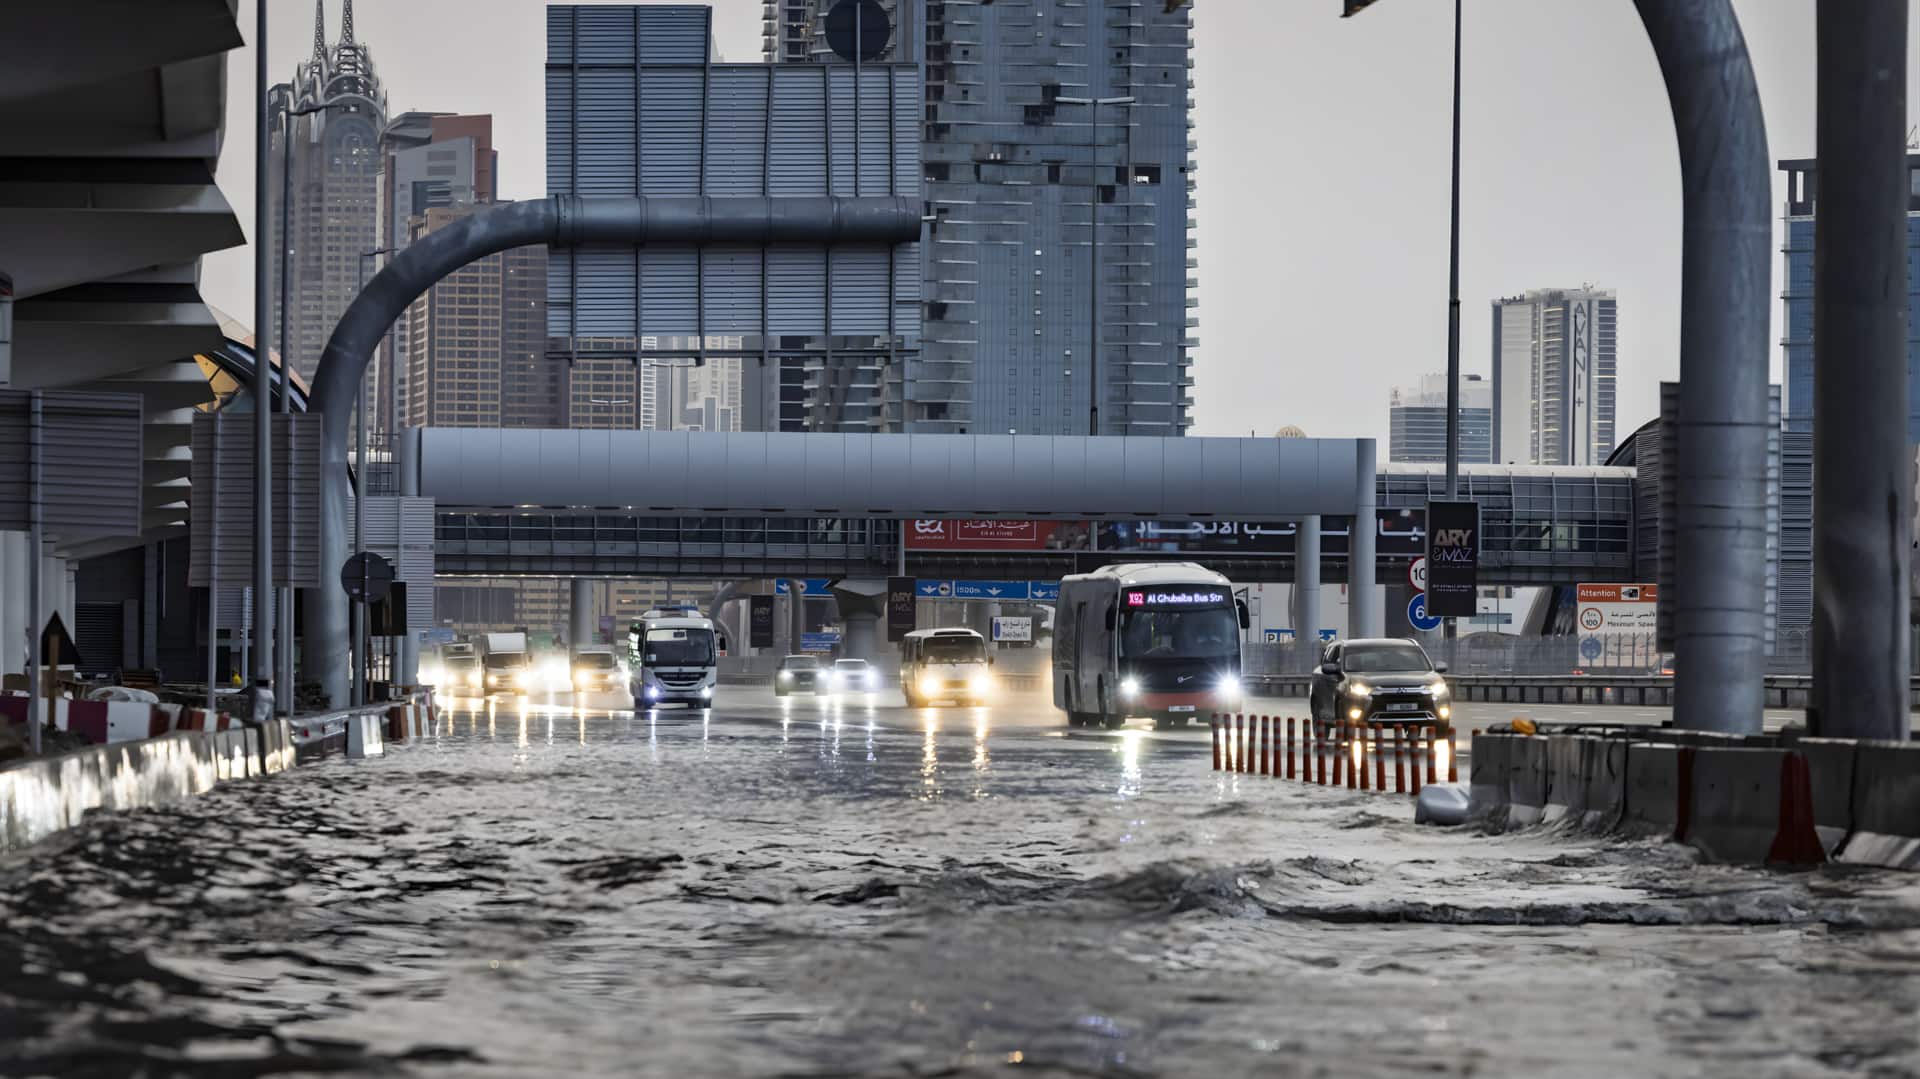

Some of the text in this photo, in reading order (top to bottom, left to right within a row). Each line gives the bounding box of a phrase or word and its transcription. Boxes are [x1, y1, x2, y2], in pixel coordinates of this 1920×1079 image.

[1433, 529, 1472, 546] ARY
[1413, 567, 1425, 580] 10
[1147, 594, 1156, 603] Al
[1194, 593, 1208, 602] Bus
[1210, 593, 1223, 602] Stn
[1580, 589, 1616, 597] Attention
